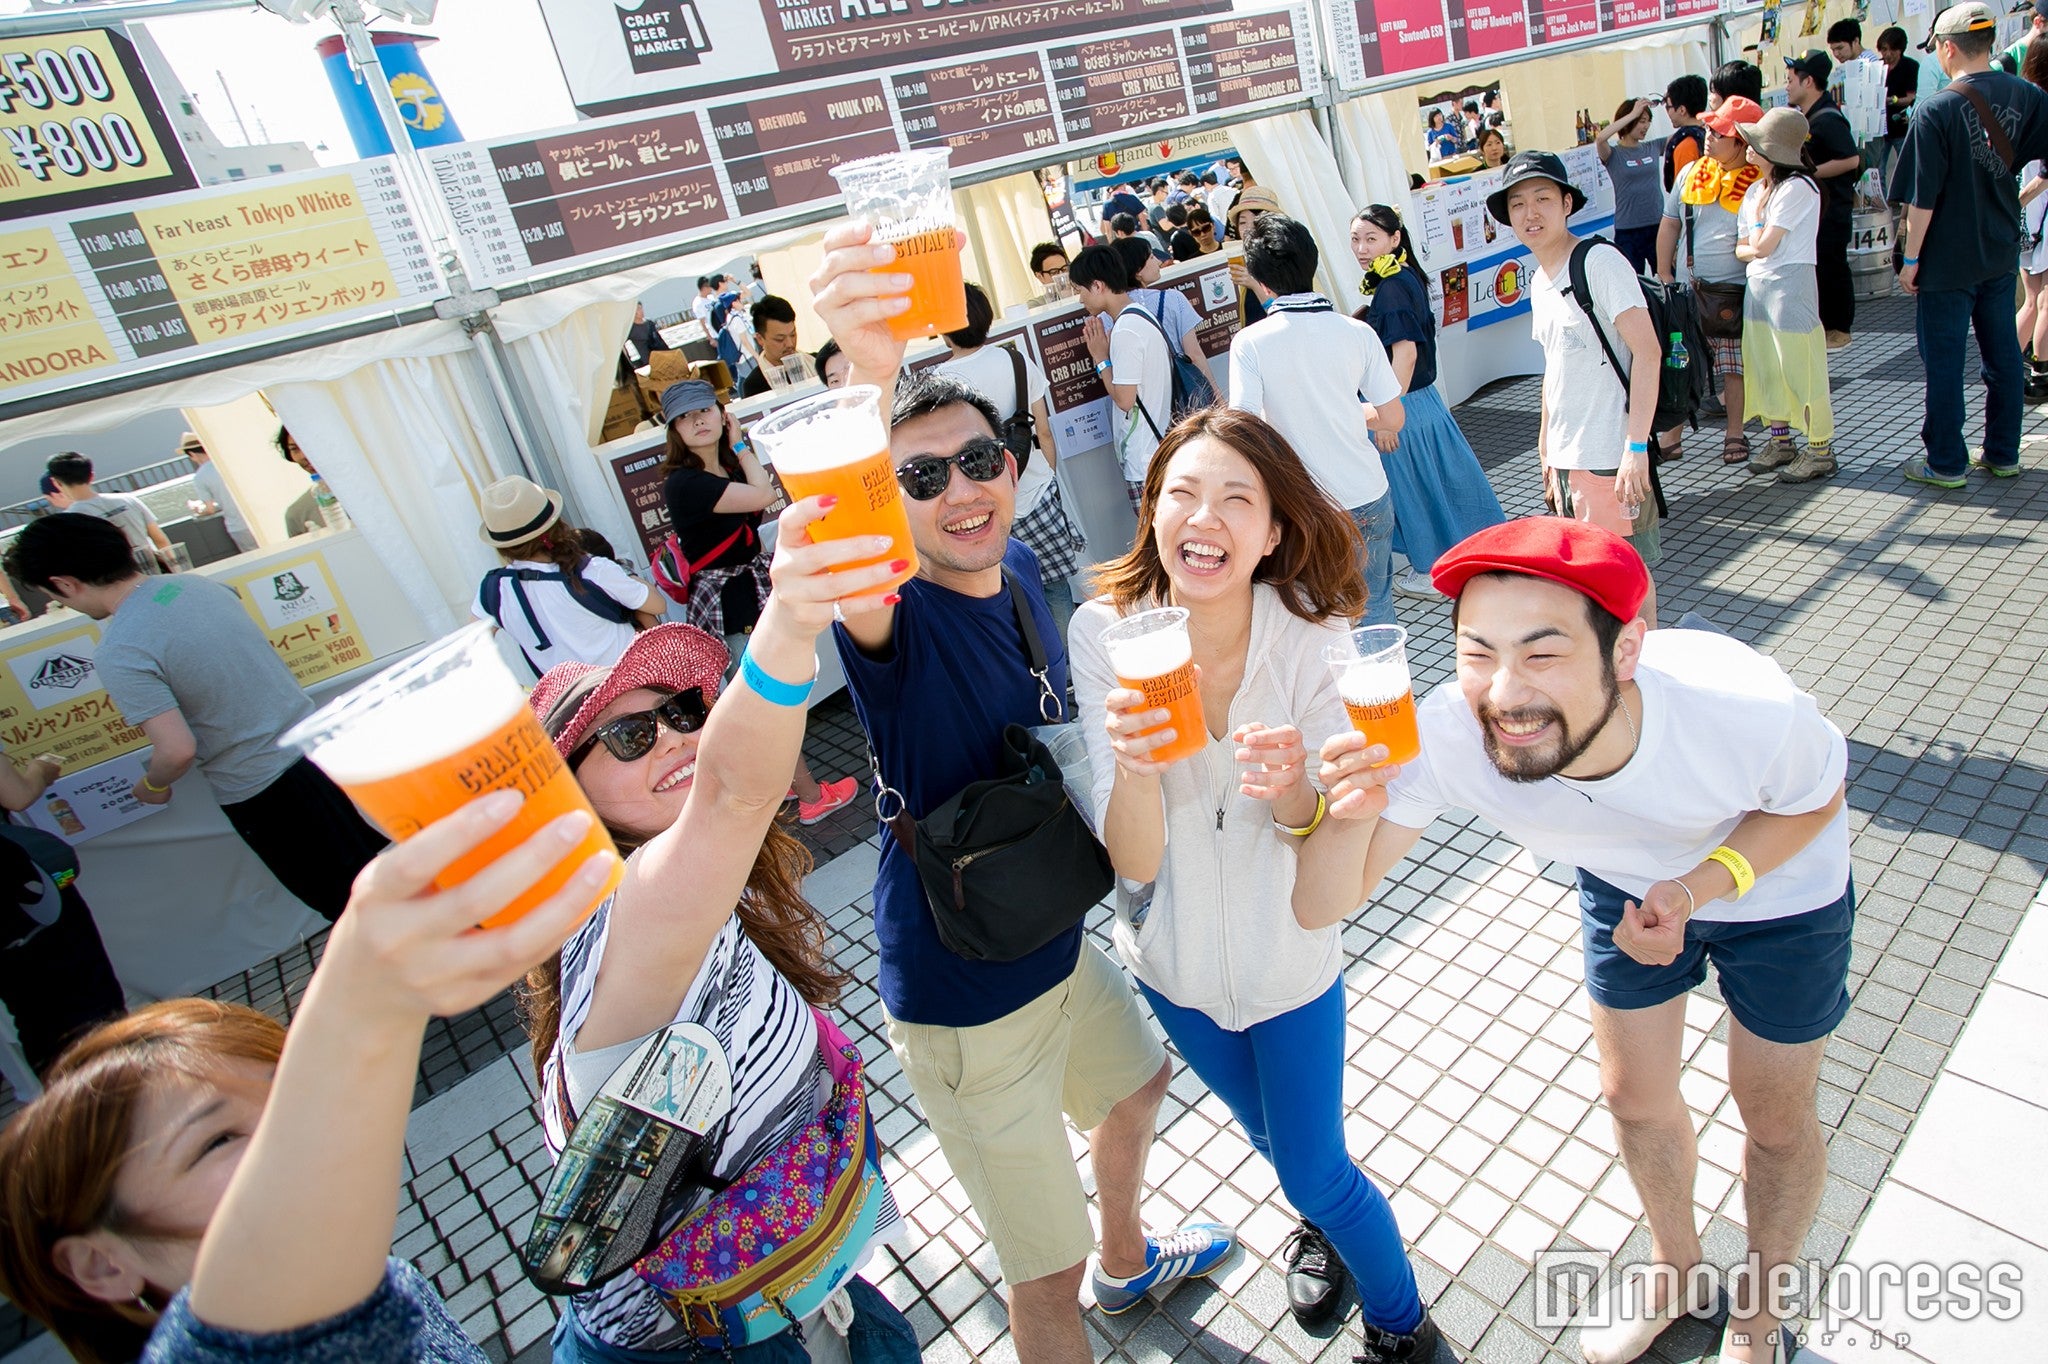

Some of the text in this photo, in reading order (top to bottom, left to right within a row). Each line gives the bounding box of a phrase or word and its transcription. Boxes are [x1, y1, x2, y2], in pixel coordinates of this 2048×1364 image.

[625, 11, 671, 28] CRAFT
[779, 5, 836, 31] MARKET
[1512, 11, 1524, 24] IPA
[629, 26, 668, 42] BEER
[1236, 23, 1291, 45] Africa Pale Ale
[1430, 24, 1444, 38] ESB
[634, 38, 688, 56] MARKET
[791, 28, 912, 61] クラフトビアマーケット
[0, 45, 115, 113] 500
[1121, 72, 1181, 97] CRB PALE ALE
[1247, 77, 1300, 101] HARDCORE IPA
[758, 95, 884, 132] BREWDOG PUNK IPA
[1, 112, 147, 181] ¥800
[1023, 127, 1056, 148] W-IPA
[1177, 130, 1229, 152] Brewing
[153, 191, 353, 240] Far Yeast Tokyo White
[611, 193, 718, 230] ブラウンエール
[1854, 227, 1889, 250] 144
[171, 243, 263, 273] あくらビール
[192, 280, 311, 316] 御殿場高原ビール
[1212, 310, 1238, 326] Saison
[1050, 357, 1091, 383] CRB PALE
[325, 635, 355, 653] ¥500
[331, 647, 361, 665] ¥800
[111, 727, 146, 746] ¥800
